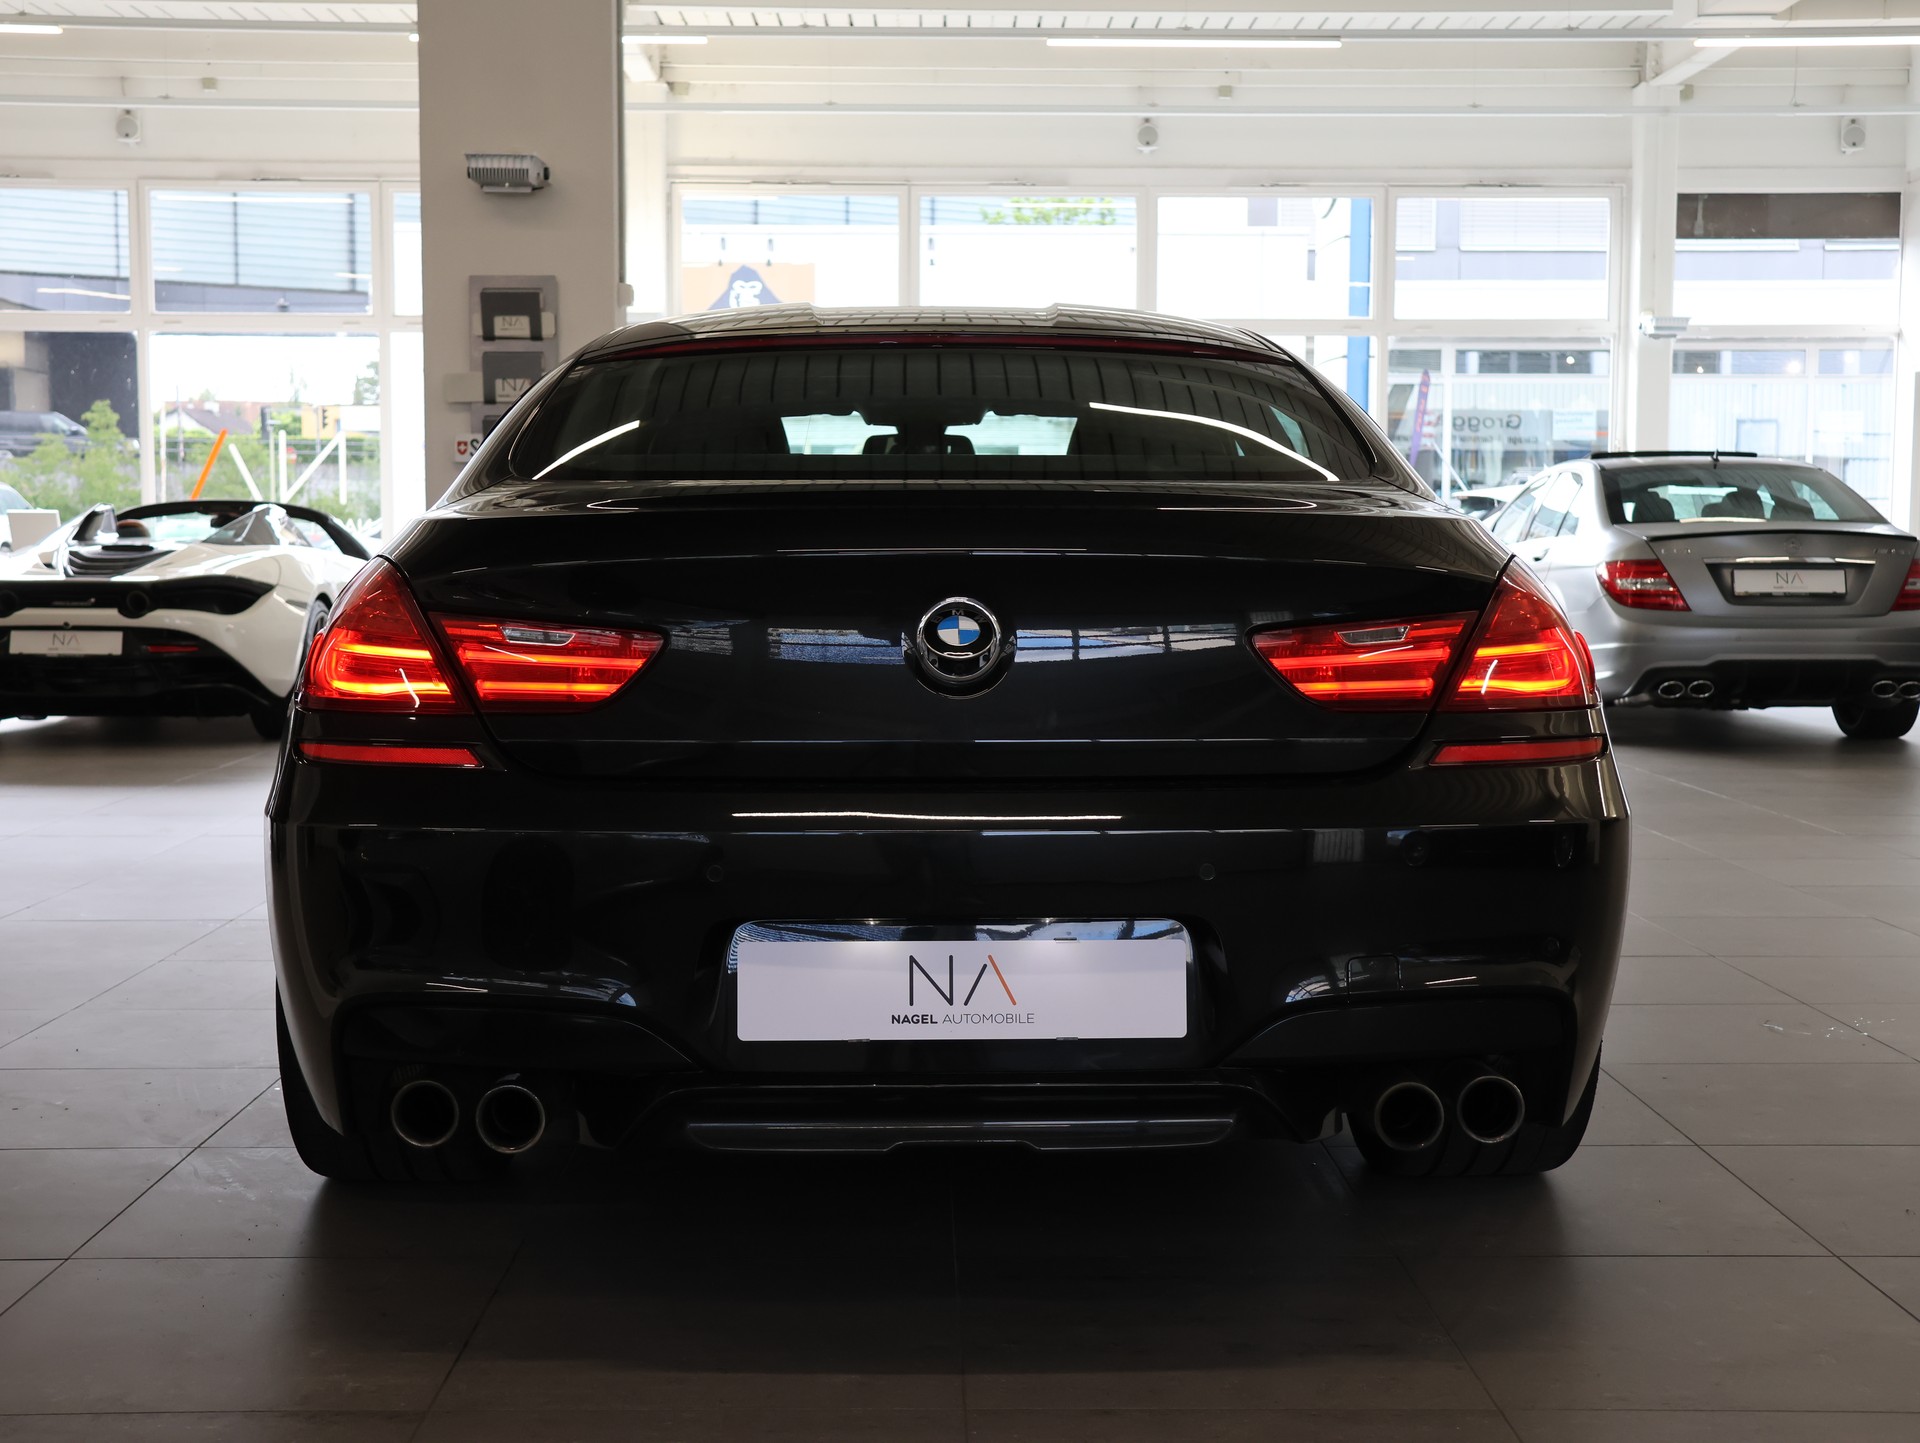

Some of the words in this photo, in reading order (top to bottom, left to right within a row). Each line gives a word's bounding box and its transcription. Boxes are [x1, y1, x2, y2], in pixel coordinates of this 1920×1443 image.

[1776, 572, 1804, 585] NA
[931, 609, 988, 623] BMW
[909, 954, 1017, 1006] NA
[891, 1014, 938, 1025] NAGEL
[942, 1013, 1035, 1025] AUTOMOBILE
